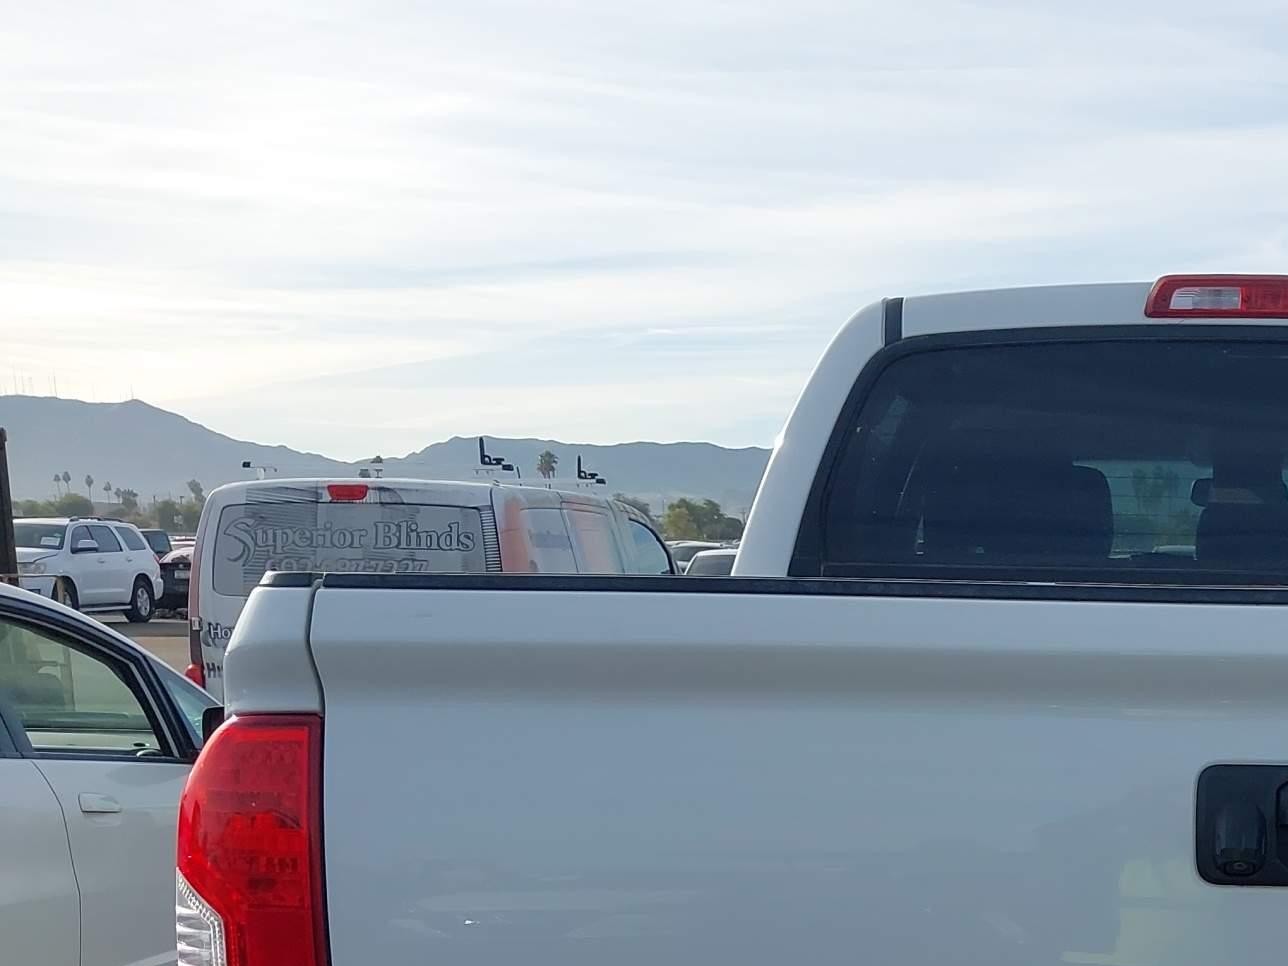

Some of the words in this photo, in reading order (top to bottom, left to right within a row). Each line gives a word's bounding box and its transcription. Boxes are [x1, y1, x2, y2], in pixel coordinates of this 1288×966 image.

[223, 517, 368, 567] Superior
[374, 521, 475, 551] Blinds
[208, 621, 236, 640] Ho
